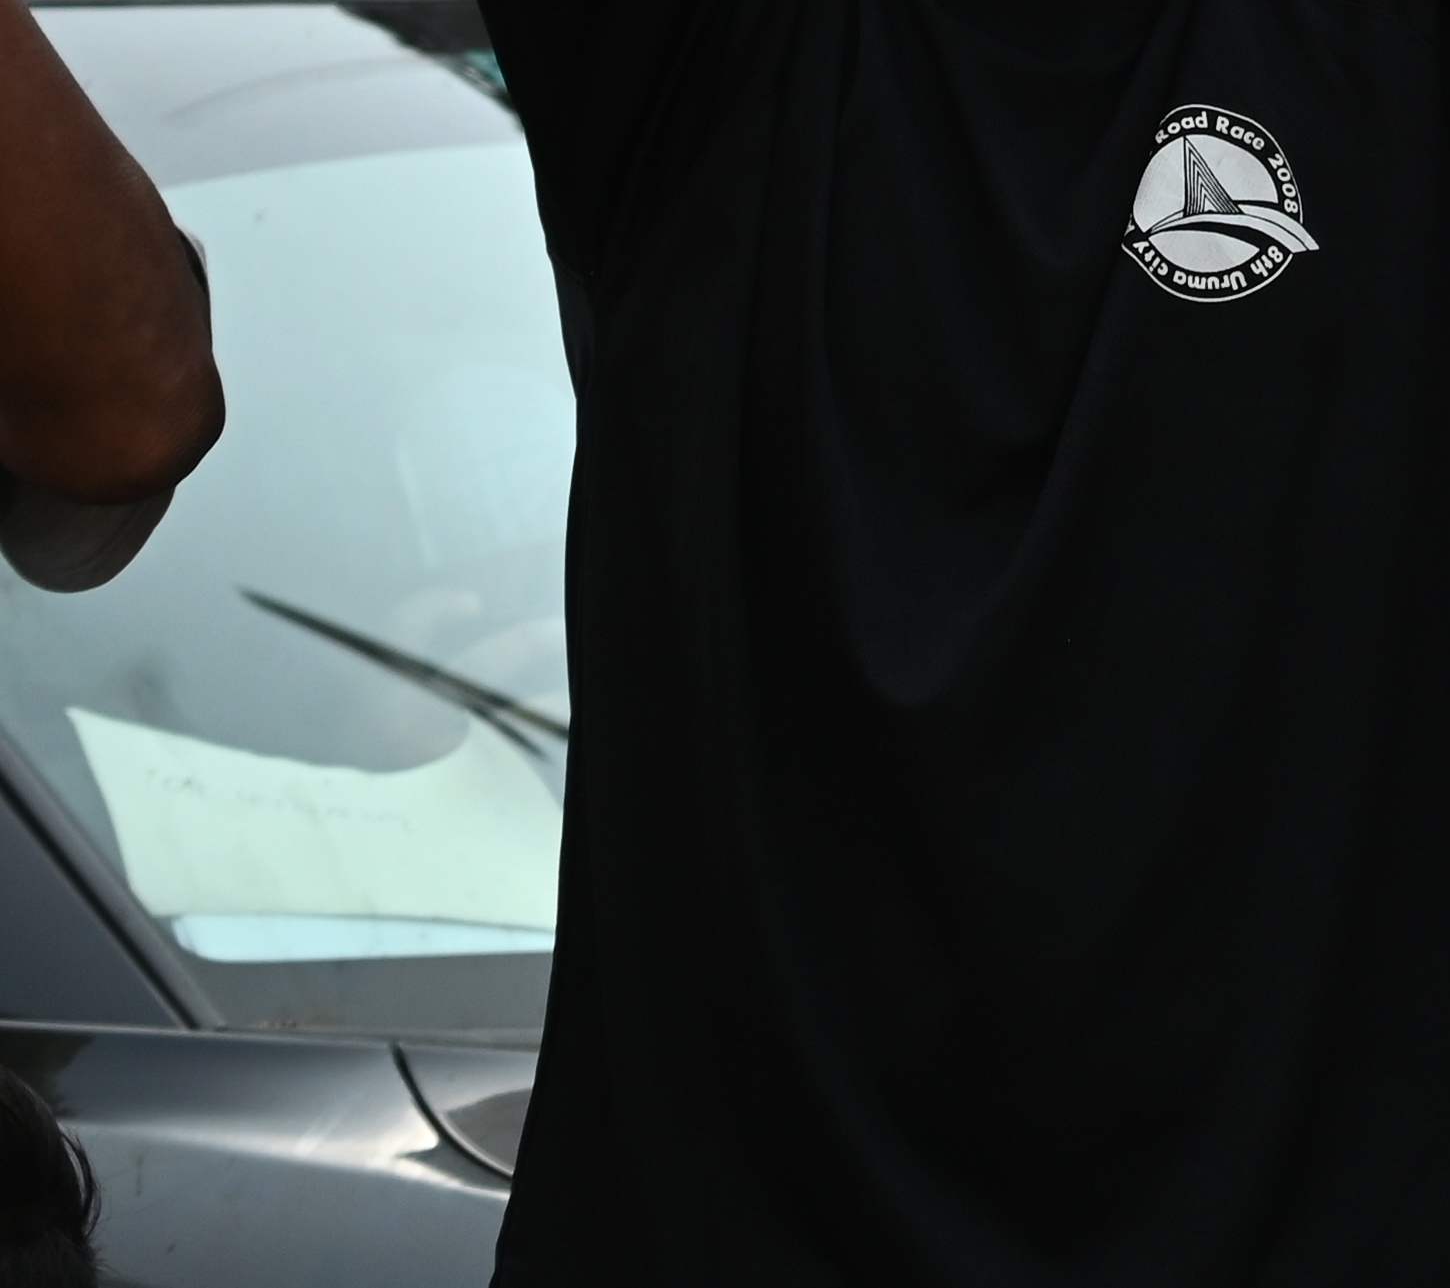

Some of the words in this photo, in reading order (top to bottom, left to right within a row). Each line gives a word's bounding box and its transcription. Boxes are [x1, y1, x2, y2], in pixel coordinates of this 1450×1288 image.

[1155, 111, 1208, 145] Road
[1216, 115, 1265, 151] Race
[1267, 153, 1299, 215] 2008
[1132, 239, 1169, 276] city
[1250, 244, 1283, 278] 8th
[1173, 270, 1247, 291] Uruma
